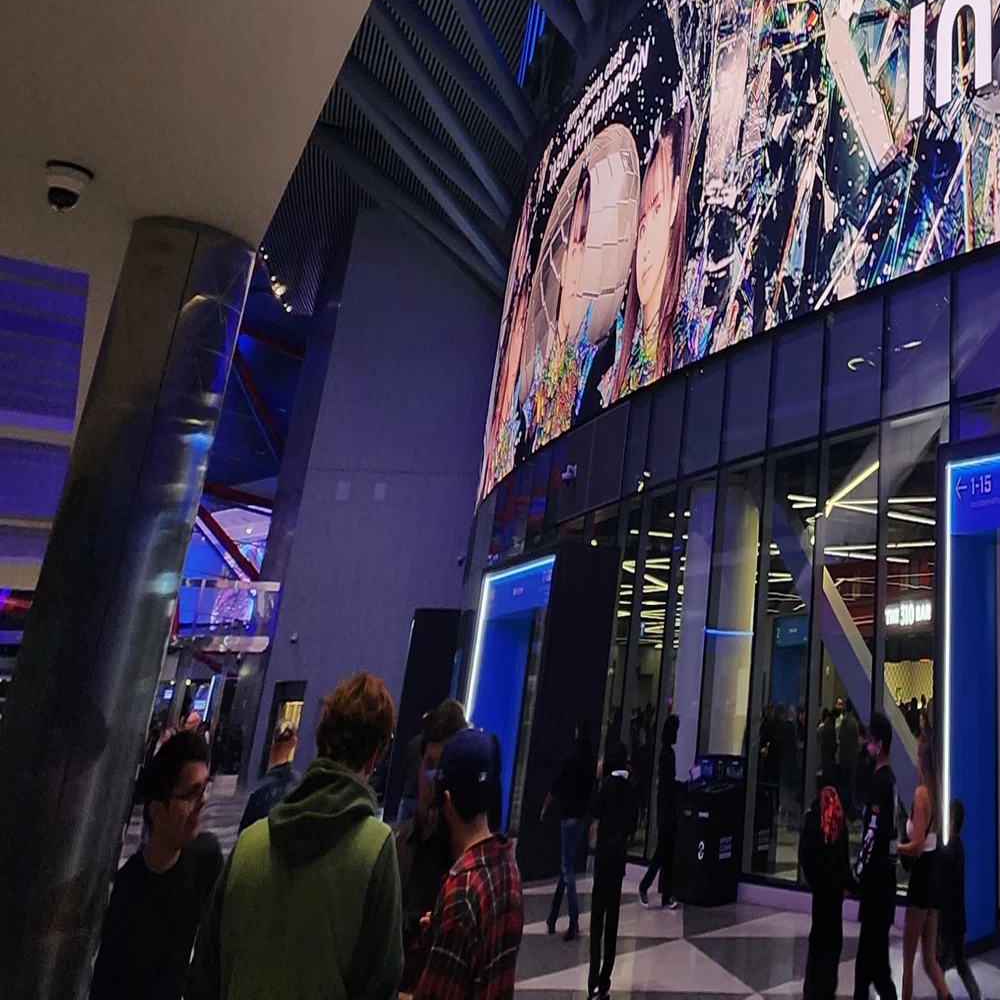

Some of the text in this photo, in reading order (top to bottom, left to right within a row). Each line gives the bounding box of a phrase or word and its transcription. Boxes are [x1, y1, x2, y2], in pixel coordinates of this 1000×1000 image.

[970, 474, 992, 495] 1-15
[884, 602, 932, 627] THE 310 BAR
